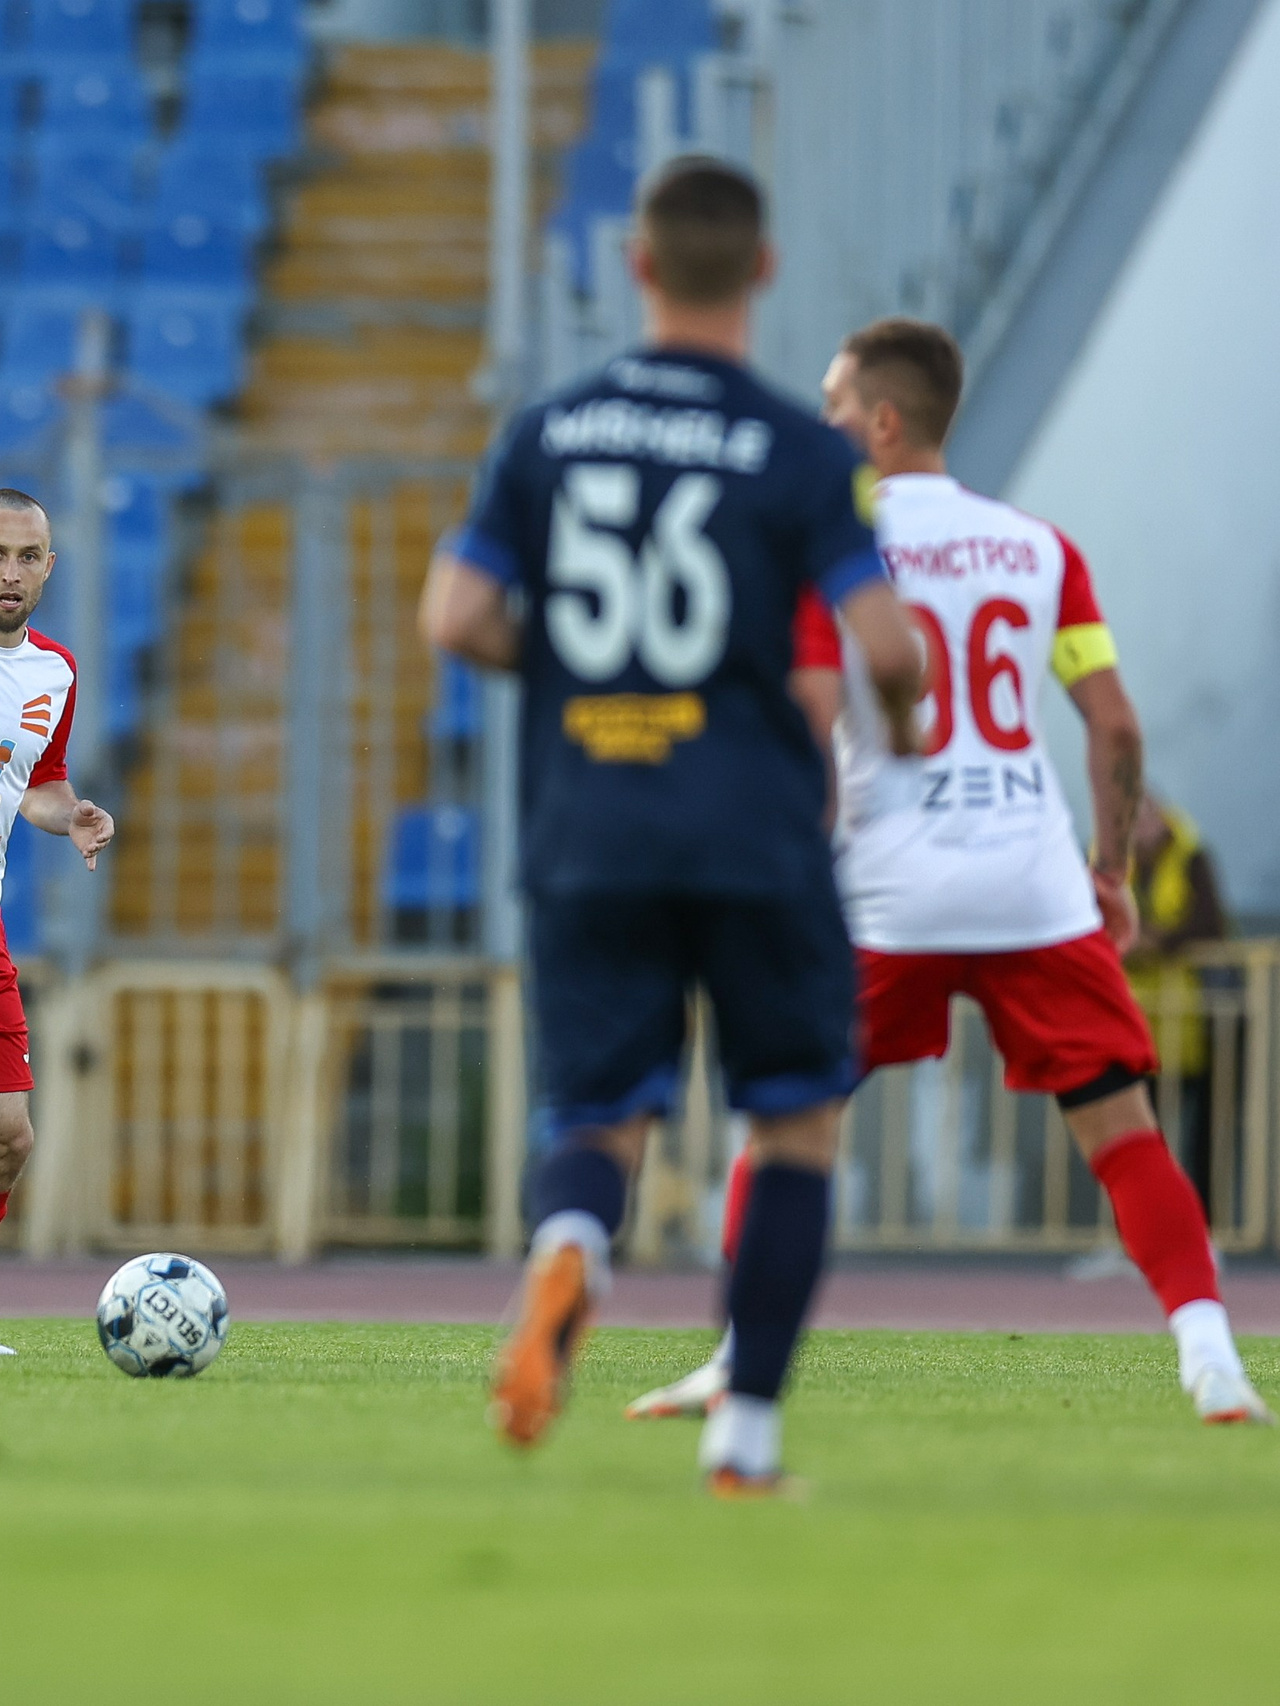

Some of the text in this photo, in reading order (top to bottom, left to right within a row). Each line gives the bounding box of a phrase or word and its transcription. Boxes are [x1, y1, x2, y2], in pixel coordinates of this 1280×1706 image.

[545, 461, 733, 690] 56
[883, 537, 1040, 578] РМИСТРОВ
[922, 762, 1043, 812] ZEN
[145, 1291, 203, 1346] SELECT
